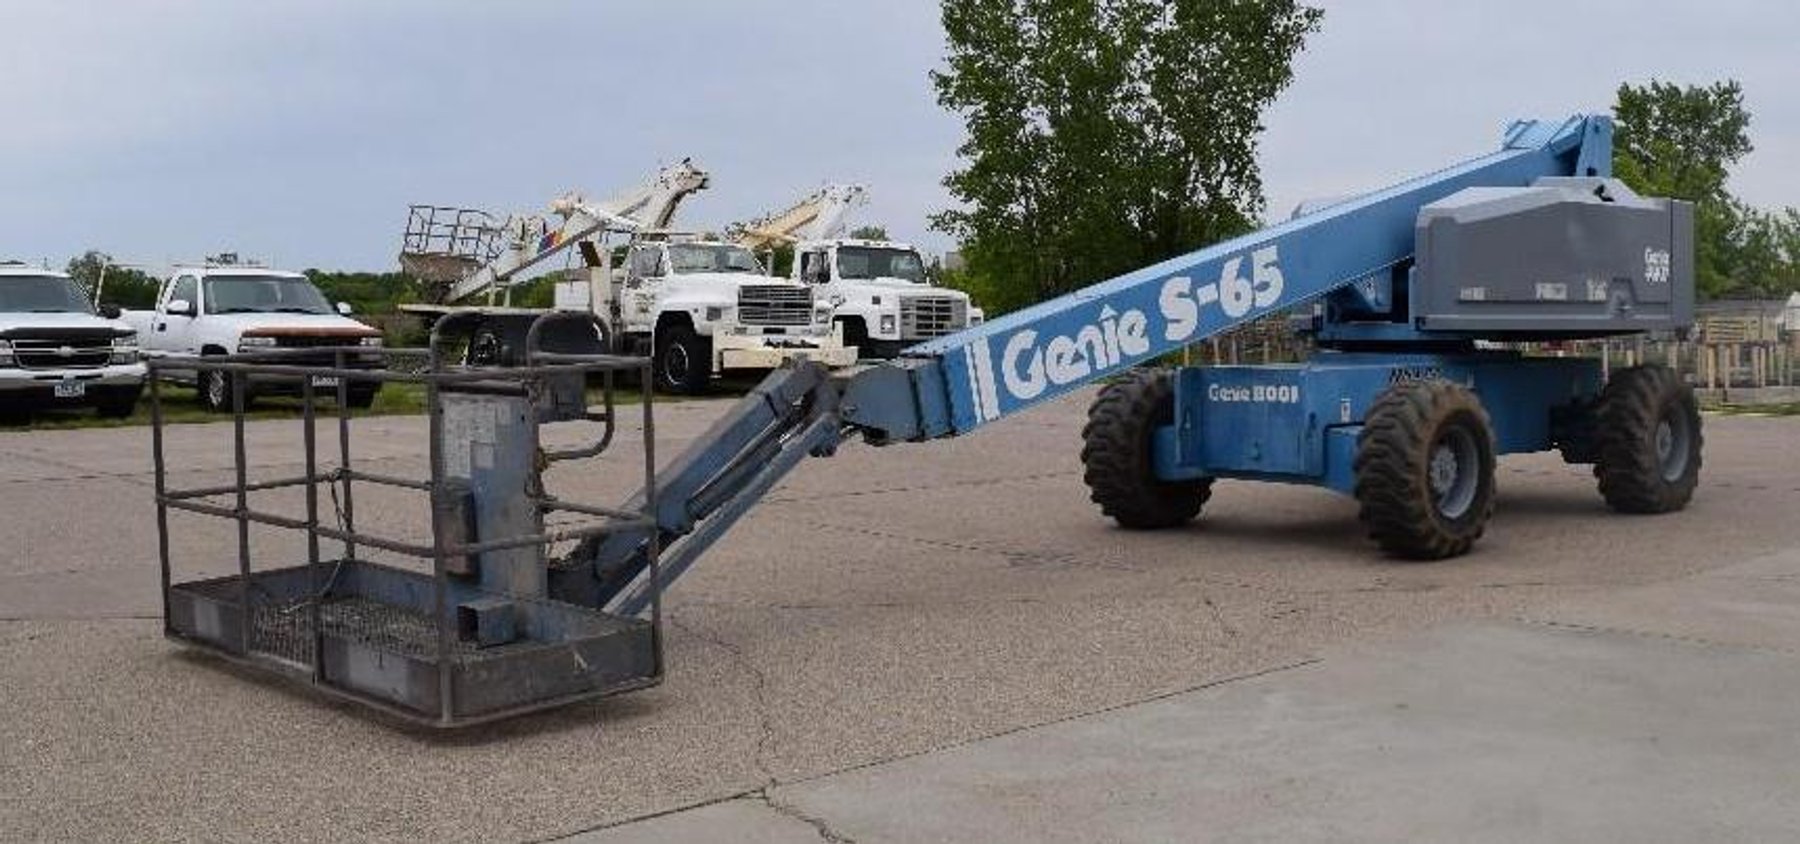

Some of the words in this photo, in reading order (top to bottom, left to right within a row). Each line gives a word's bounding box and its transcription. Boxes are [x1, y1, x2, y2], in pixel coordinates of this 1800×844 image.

[1002, 304, 1150, 399] Genie
[1158, 245, 1284, 342] S-65
[1208, 383, 1250, 402] Genie
